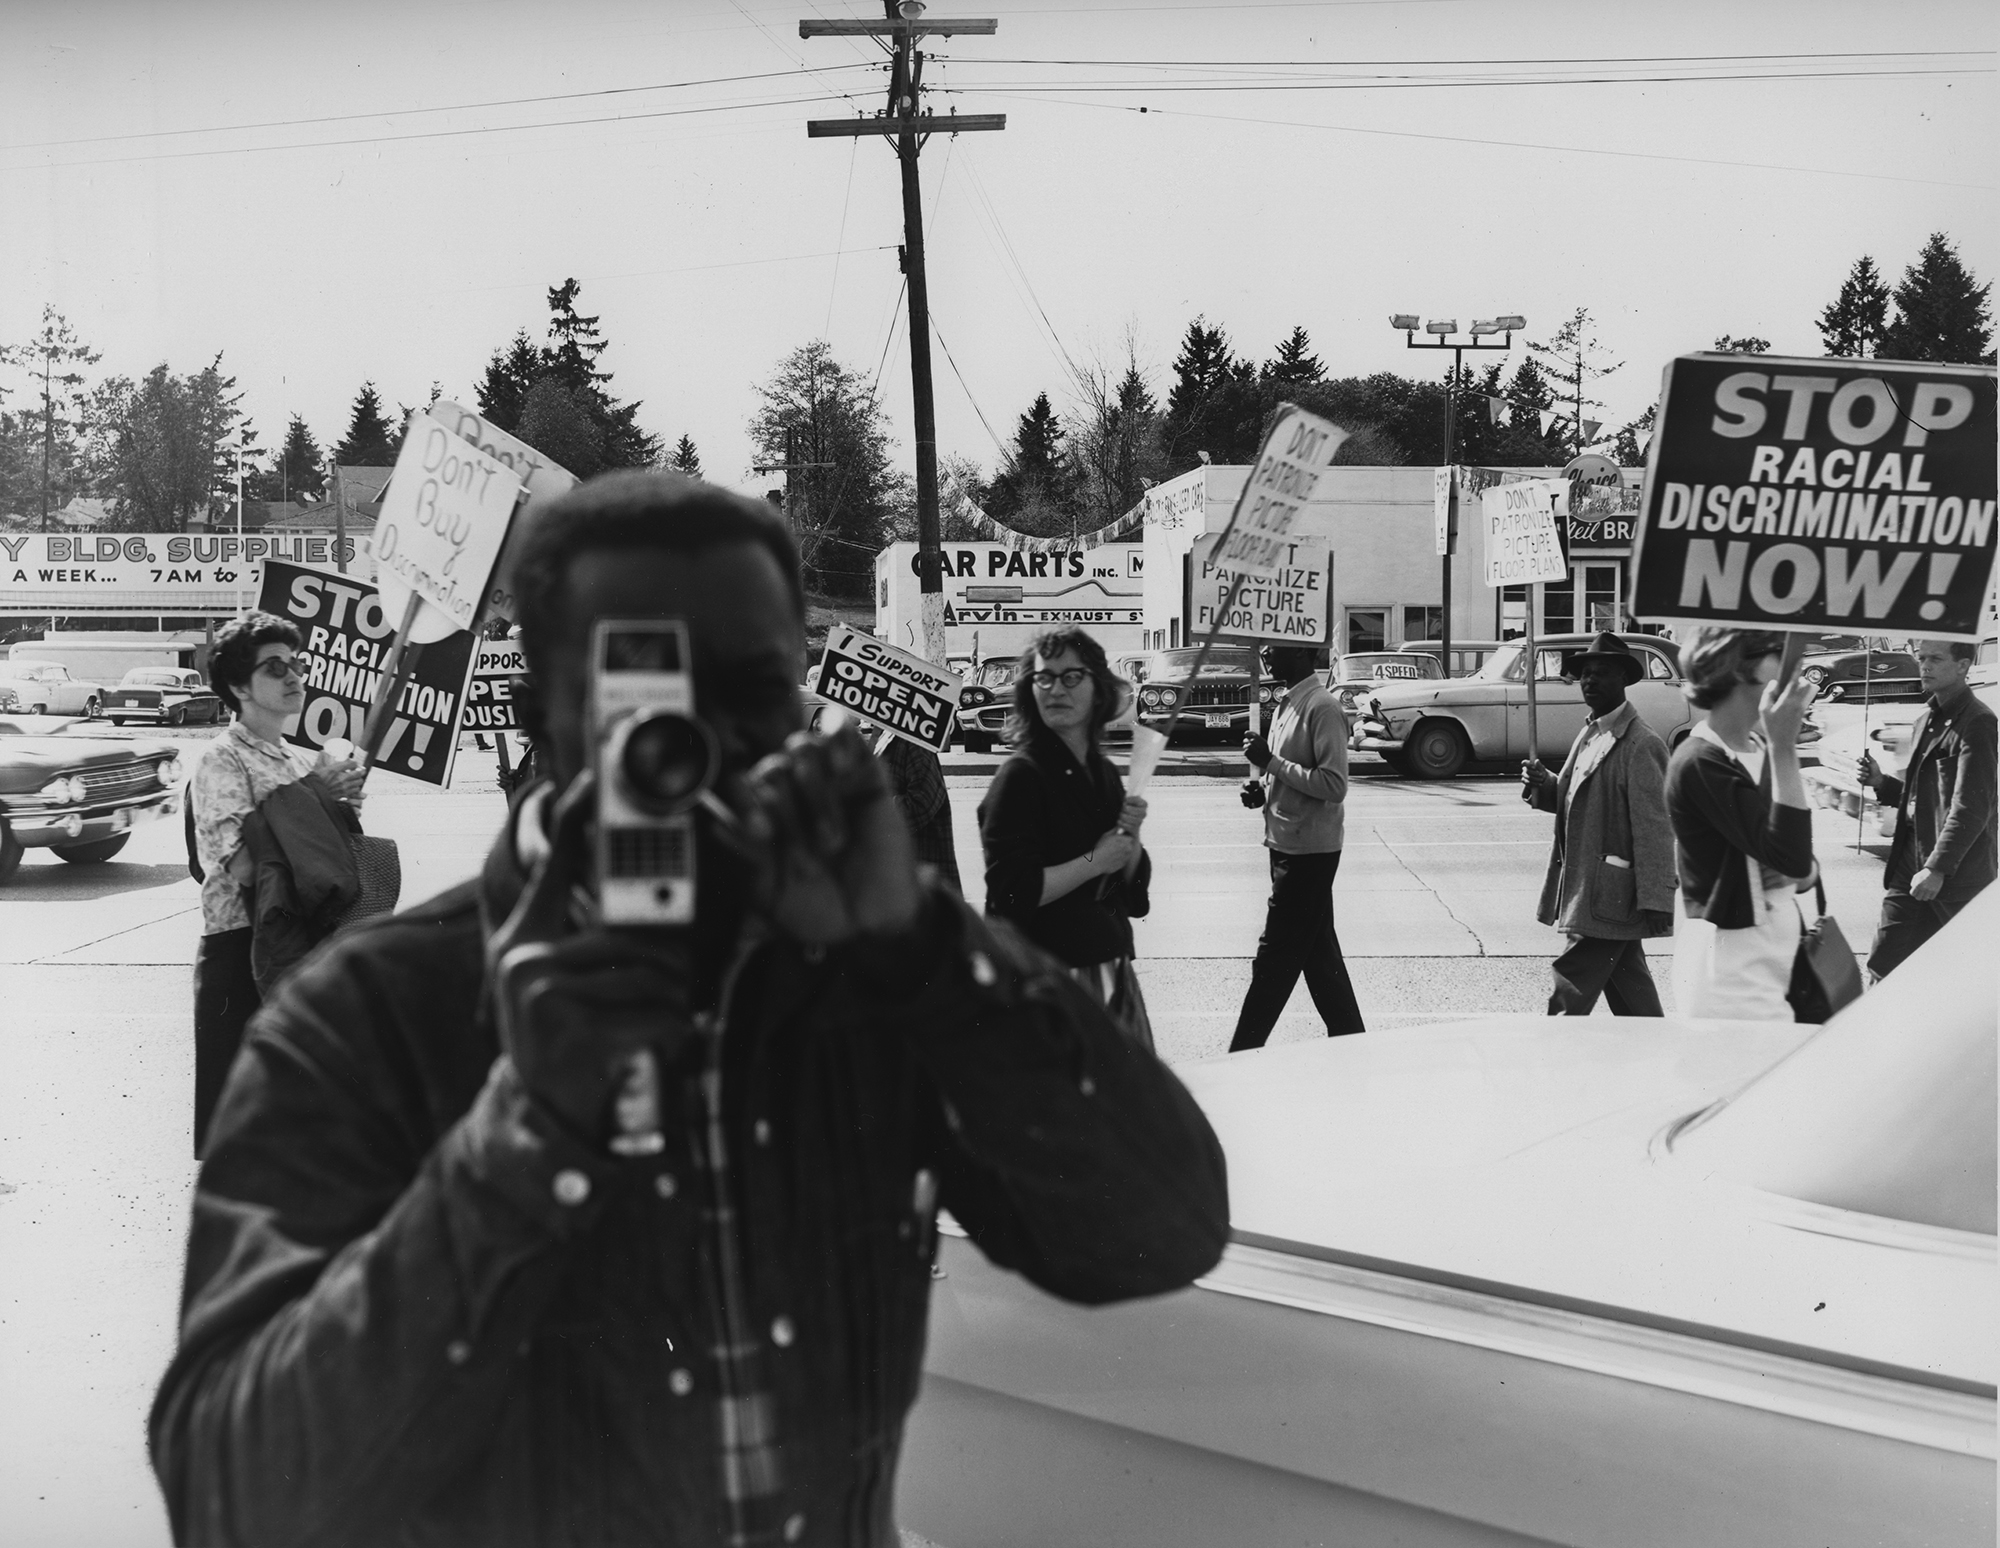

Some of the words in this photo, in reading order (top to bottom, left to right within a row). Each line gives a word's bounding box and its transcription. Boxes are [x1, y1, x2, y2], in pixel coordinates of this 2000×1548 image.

[1712, 371, 1974, 447] STOP
[422, 428, 497, 506] Don't
[1749, 446, 1931, 491] RACIAL
[1505, 487, 1537, 511] DON'T
[1658, 482, 1996, 547] DISCRIMINATION
[416, 478, 470, 576] Buy
[1492, 510, 1553, 535] PATRONIZE
[47, 537, 156, 563] BLDG.
[167, 536, 356, 564] SUPPLIES
[1503, 532, 1552, 557] PICTURE
[12, 569, 28, 582] A
[38, 569, 117, 582] WEEK...
[213, 567, 238, 583] to
[988, 551, 1085, 578] PARTS
[1093, 568, 1119, 578] INC.
[1493, 558, 1526, 579] FLOOR
[1530, 555, 1561, 576] PLANS
[1678, 539, 1962, 621] NOW!
[287, 575, 394, 640] STO
[943, 599, 1018, 627] Arvin
[1041, 612, 1114, 622] EXHAUST
[1199, 605, 1253, 631] FLOOR
[1261, 613, 1318, 637] PLANS
[308, 625, 416, 680] RACIA
[475, 652, 525, 669] PPOR
[839, 634, 855, 650] I
[857, 644, 950, 692] SUPPORT
[1375, 665, 1385, 678] 4
[468, 679, 513, 701] PE
[835, 661, 942, 719] OPEN
[826, 677, 937, 739] HOUSING
